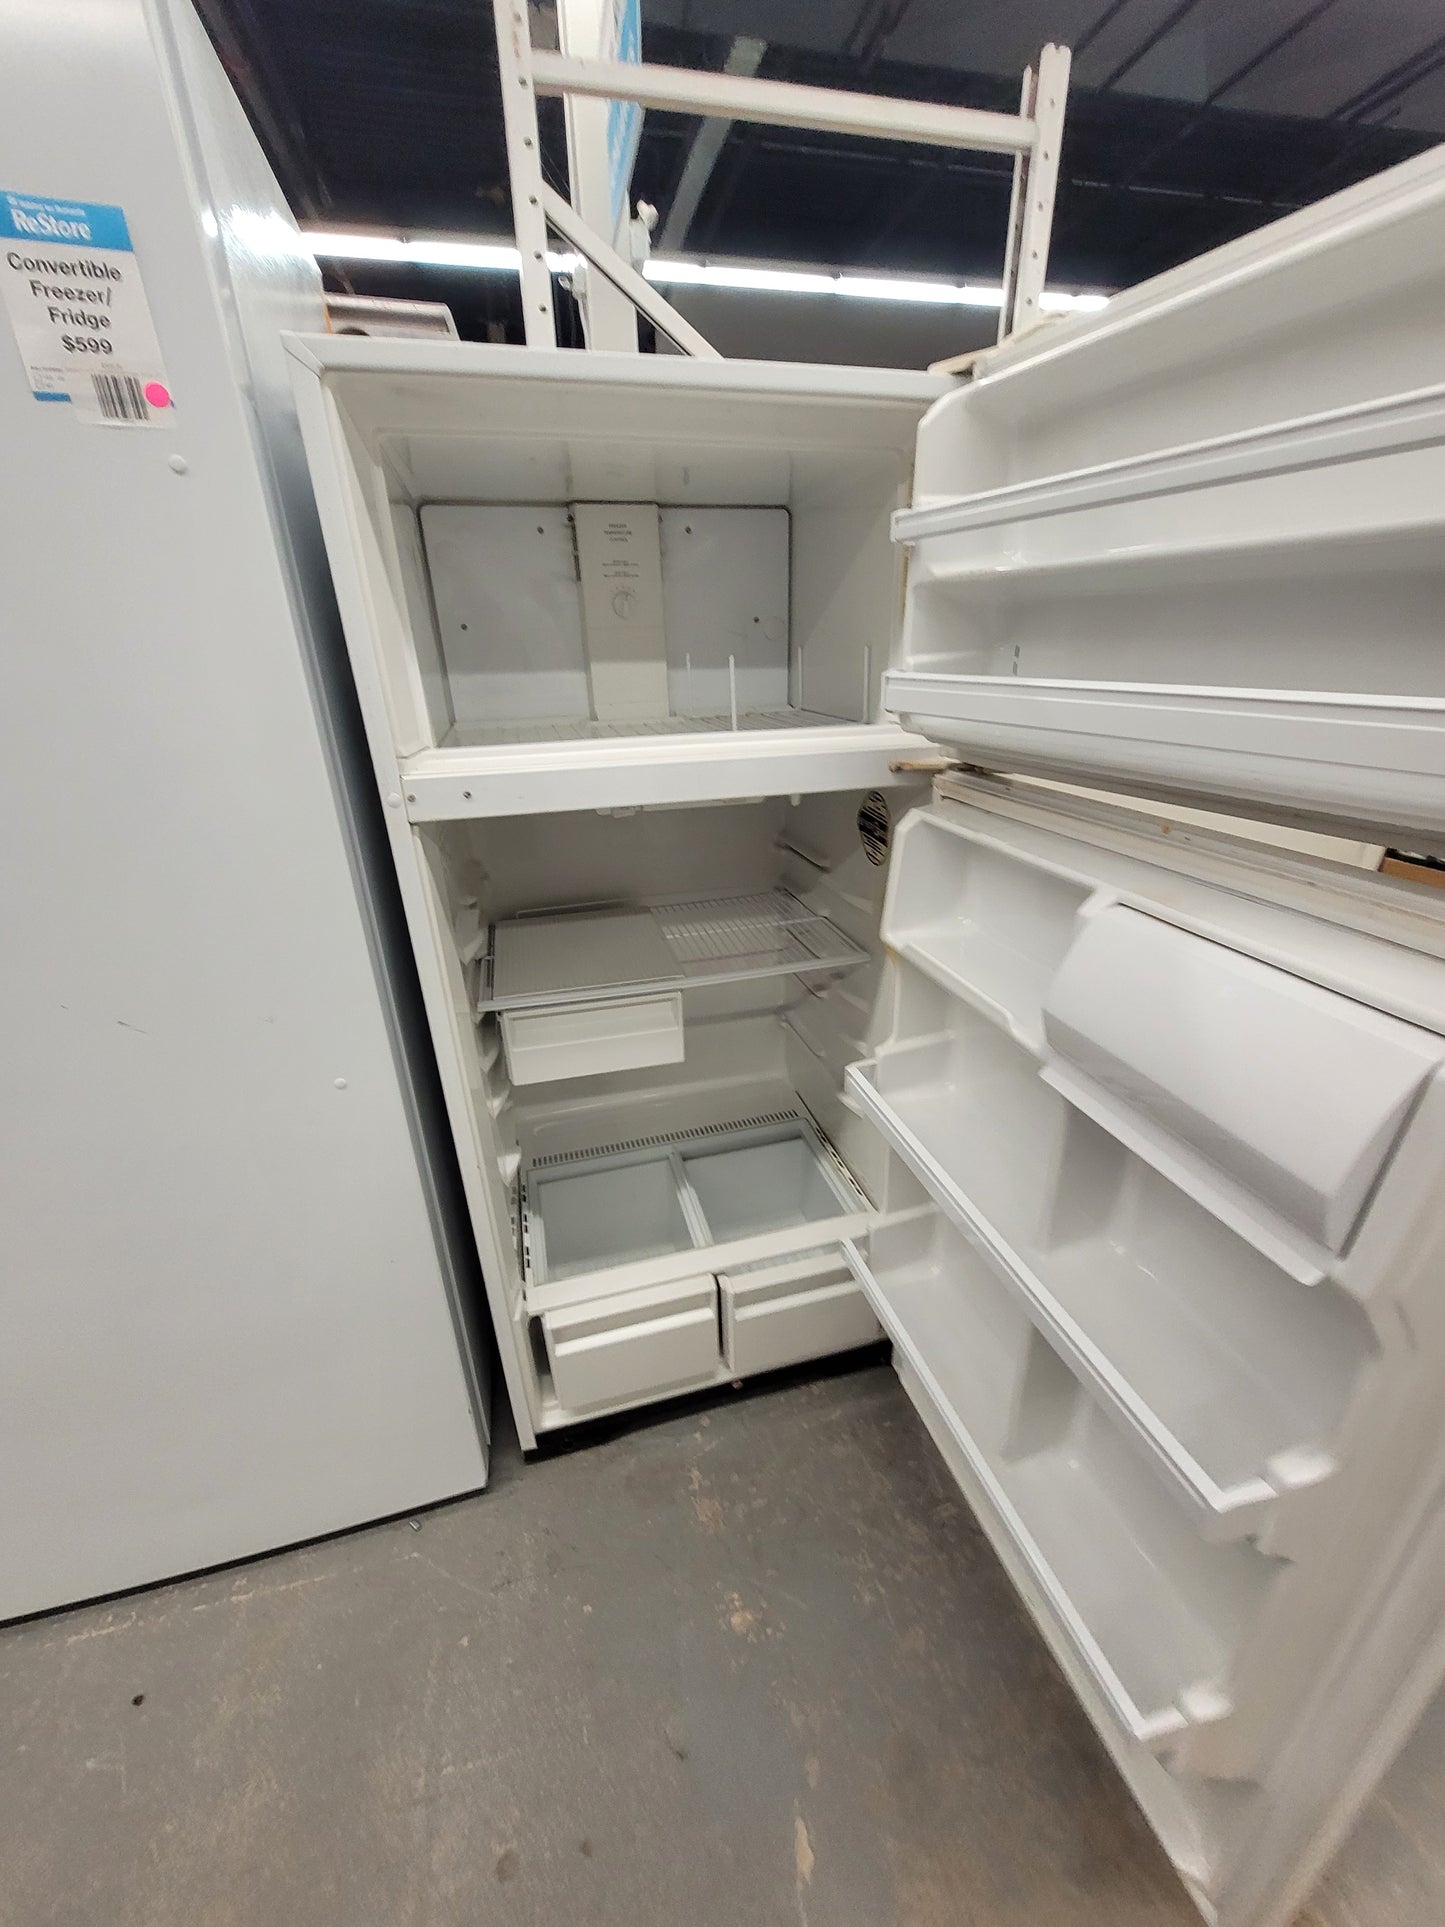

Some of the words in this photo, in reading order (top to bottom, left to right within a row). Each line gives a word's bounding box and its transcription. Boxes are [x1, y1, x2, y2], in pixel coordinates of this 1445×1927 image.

[11, 208, 91, 240] ReStore
[7, 251, 122, 281] Convertible
[29, 279, 112, 307] Freezer/
[47, 306, 111, 330] Fridge
[60, 334, 113, 354] $599
